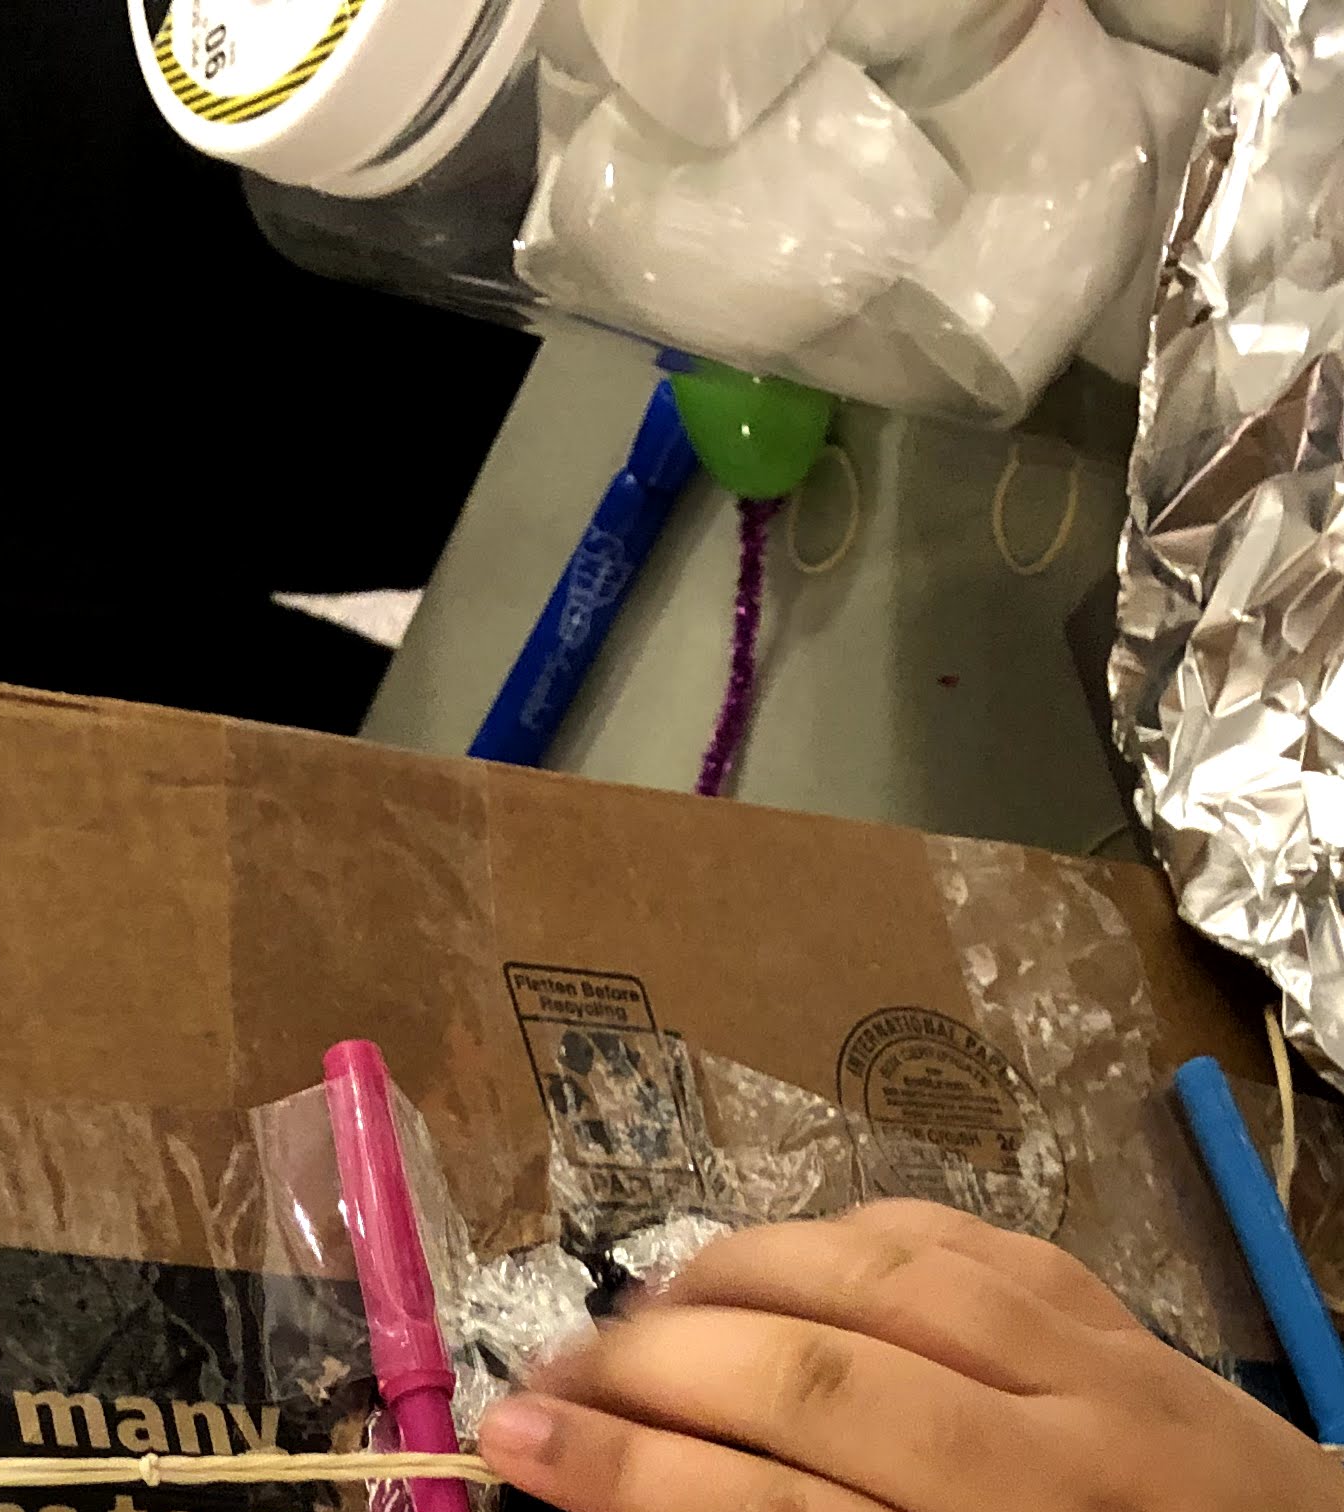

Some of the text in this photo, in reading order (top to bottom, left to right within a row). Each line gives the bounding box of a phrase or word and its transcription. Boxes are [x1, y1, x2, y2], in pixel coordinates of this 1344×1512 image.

[581, 981, 640, 1002] Before
[540, 995, 628, 1022] Recycling
[846, 1015, 955, 1078] INTERNATIONAL
